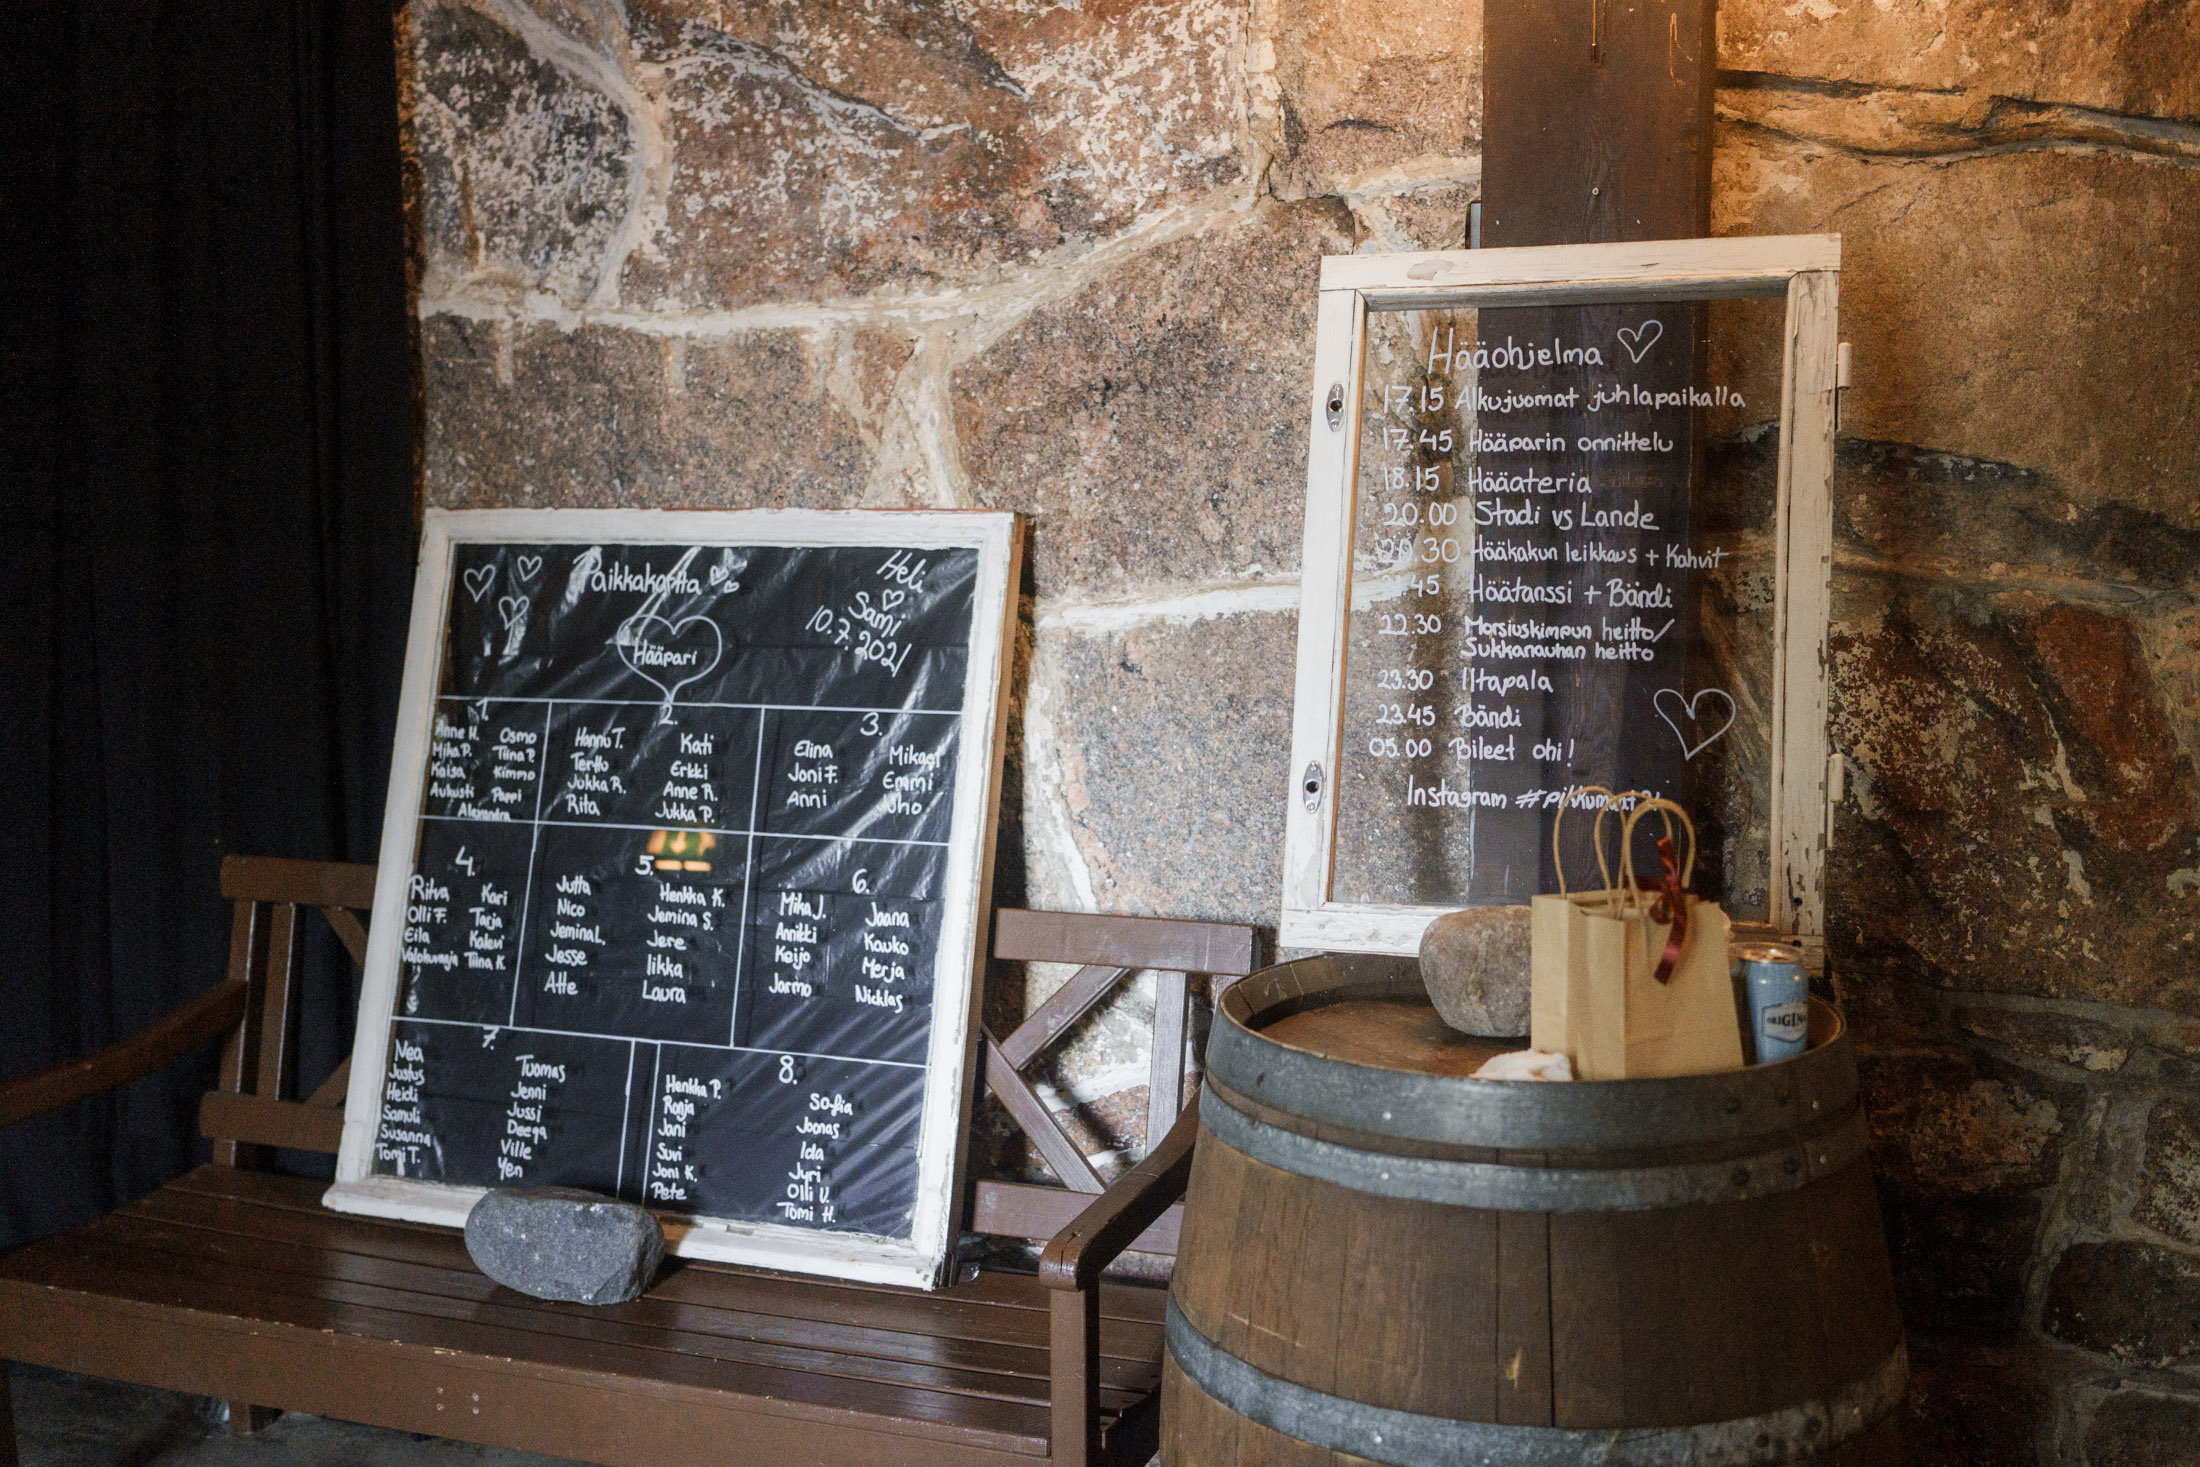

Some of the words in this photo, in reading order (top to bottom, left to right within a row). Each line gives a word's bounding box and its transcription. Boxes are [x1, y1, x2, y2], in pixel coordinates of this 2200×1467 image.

[1427, 326, 1603, 374] Hääohjelma
[1383, 384, 1444, 413] 17.15
[1455, 384, 1579, 413] Alkujuomat
[1587, 383, 1746, 412] juhlapaikalla
[1383, 426, 1453, 452] 17.45
[1469, 428, 1565, 453] Hääparin
[1577, 431, 1674, 452] onnittelu
[1383, 463, 1440, 491] 18.15
[1468, 466, 1592, 493] Hääateria
[1383, 502, 1458, 527] 20.00
[1473, 497, 1541, 527] Stadi
[1552, 509, 1573, 531] vs
[1580, 499, 1660, 531] Lande
[1378, 537, 1461, 563] 20.30
[1471, 534, 1558, 562] Hääkakun
[1565, 541, 1637, 564] leikkaus
[1666, 543, 1730, 569] Kahvit
[876, 549, 926, 593] Heli
[1469, 573, 1573, 604] Häätanssi
[1606, 577, 1673, 609] Bändi
[848, 591, 906, 638] Sami
[1378, 613, 1442, 636] 22.30
[1464, 614, 1592, 640] Morsiuskimpun
[633, 637, 698, 667] Hääpari
[1460, 637, 1586, 659] Sukkanauhan
[1595, 641, 1655, 662] heitto
[1377, 668, 1434, 691] 23.30
[1462, 667, 1553, 697] Iltapala
[658, 703, 678, 726] 2.
[859, 711, 883, 737] 3.
[1375, 703, 1436, 727] 23.45
[1454, 704, 1522, 729] Bändi
[435, 719, 465, 739] Anne
[468, 725, 479, 741] H.
[500, 727, 537, 744] Osmo
[574, 726, 611, 749] Hannu
[611, 727, 626, 749] T.
[432, 741, 460, 759] Mika
[460, 742, 472, 758] P.
[492, 745, 525, 762] Tiina
[680, 732, 715, 756] Kati
[794, 739, 833, 759] Elina
[1369, 737, 1432, 758] 05.00
[1448, 734, 1515, 761] Bileet
[431, 761, 466, 779] Kaisa
[493, 765, 536, 781] Kimmo
[570, 751, 609, 773] Terttu
[670, 759, 709, 781] Erkki
[787, 762, 822, 784] Joni
[824, 764, 838, 785] F.
[430, 781, 475, 798] Aukusti
[567, 773, 609, 793] Jukka
[610, 775, 627, 795] R.
[662, 780, 699, 800] Anne
[701, 783, 719, 802] R.
[882, 771, 934, 792] Emmi
[1407, 774, 1507, 809] Instagram
[491, 786, 522, 804] Pappi
[565, 793, 600, 816] Rita
[786, 788, 827, 809] Anni
[457, 802, 511, 822] Alexandra
[654, 801, 697, 823] Jukka
[698, 805, 715, 824] P.
[455, 845, 476, 877] 4.
[634, 854, 655, 877] 5.
[408, 874, 450, 902] Ritva
[556, 874, 591, 896] Jutta
[852, 868, 870, 894] 6.
[481, 882, 508, 906] Kari
[660, 882, 706, 907] Henkka
[711, 887, 726, 908] K.
[779, 891, 812, 917] Mika
[811, 894, 827, 920] J.
[407, 905, 432, 924] Olli
[432, 907, 447, 924] F.
[468, 907, 502, 931] Tarja
[557, 898, 585, 917] Nico
[647, 905, 698, 928] Jemina
[702, 911, 714, 932] S.
[865, 902, 910, 928] Jaana
[404, 926, 431, 944] Eila
[469, 929, 505, 950] Kalevi
[646, 929, 687, 951] Jere
[775, 921, 817, 944] Annikki
[863, 932, 909, 956] Kauko
[463, 951, 493, 970] Tiina
[495, 955, 506, 970] K.
[545, 943, 588, 967] Jesse
[775, 944, 811, 970] Keijo
[862, 956, 905, 984] Merja
[544, 971, 578, 996] Atte
[642, 979, 686, 1004] Laura
[768, 972, 812, 997] Jarmo
[855, 984, 903, 1014] Nicklas
[482, 1026, 500, 1050] 7.
[394, 1038, 424, 1063] Nea
[388, 1062, 425, 1086] Justus
[515, 1054, 566, 1083] Tuomas
[778, 1055, 798, 1085] 8.
[386, 1081, 418, 1103] Heidi
[510, 1081, 547, 1101] Jenni
[665, 1073, 708, 1098] Henkka
[708, 1079, 722, 1100] P.
[382, 1104, 421, 1124] Samuli
[506, 1101, 543, 1123] Jussi
[662, 1095, 695, 1122] Ronja
[809, 1092, 853, 1117] Sofia
[380, 1123, 431, 1147] Susanna
[796, 1116, 841, 1139] Joonas
[375, 1143, 406, 1163] Tomi
[406, 1147, 421, 1164] T.
[500, 1138, 533, 1160] Ville
[656, 1142, 683, 1162] Suvi
[800, 1141, 824, 1162] Ida
[497, 1156, 523, 1181] Yen
[652, 1162, 680, 1180] Joni
[684, 1165, 698, 1182] K.
[788, 1161, 822, 1184] Jyri
[651, 1181, 687, 1200] Pete
[786, 1183, 813, 1202] Olli
[776, 1201, 813, 1222] Tomi
[822, 1205, 836, 1223] H.
